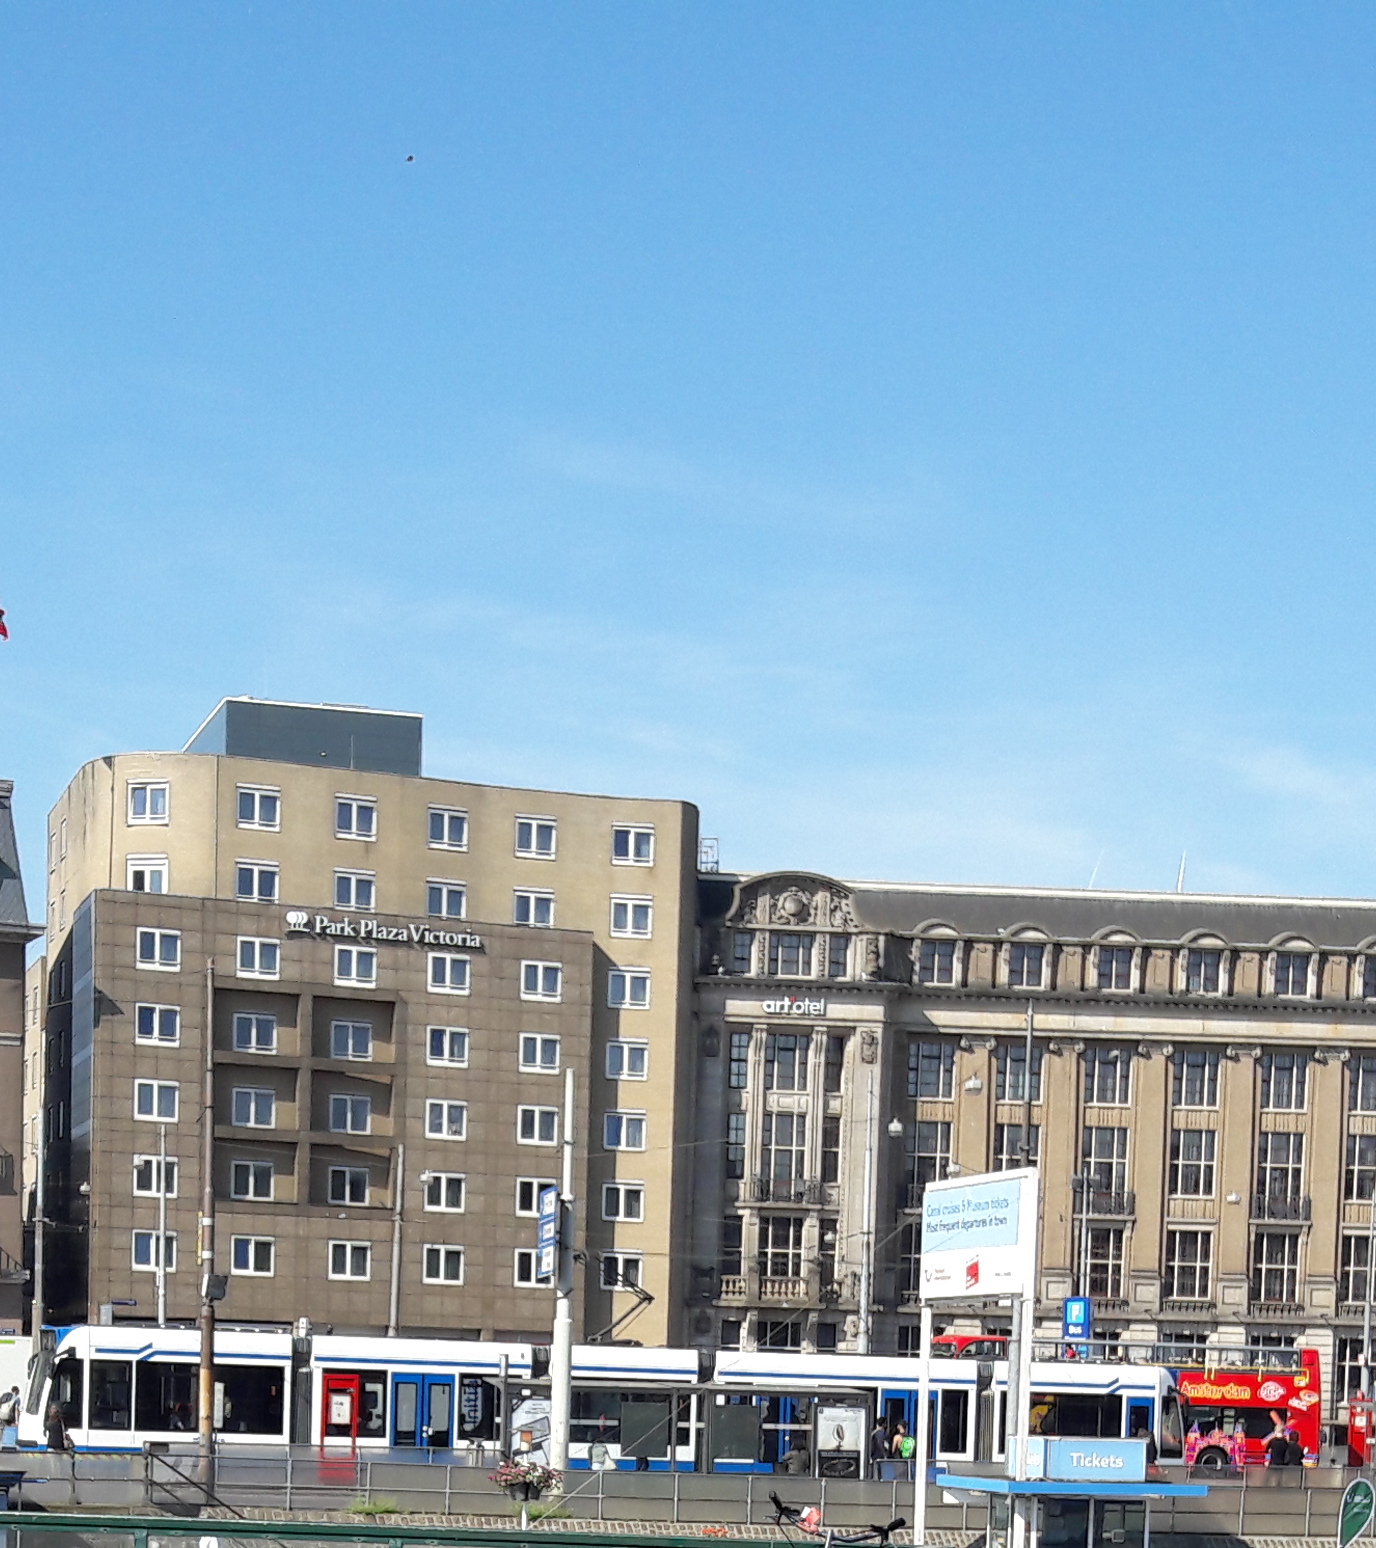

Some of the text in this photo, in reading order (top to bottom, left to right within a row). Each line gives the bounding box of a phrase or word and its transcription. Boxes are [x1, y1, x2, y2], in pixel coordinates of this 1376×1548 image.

[315, 915, 482, 948] Park Plaza Victoria
[1071, 1304, 1080, 1321] F
[1181, 1380, 1251, 1399] Amsterdam
[1070, 1451, 1124, 1469] Tickets
